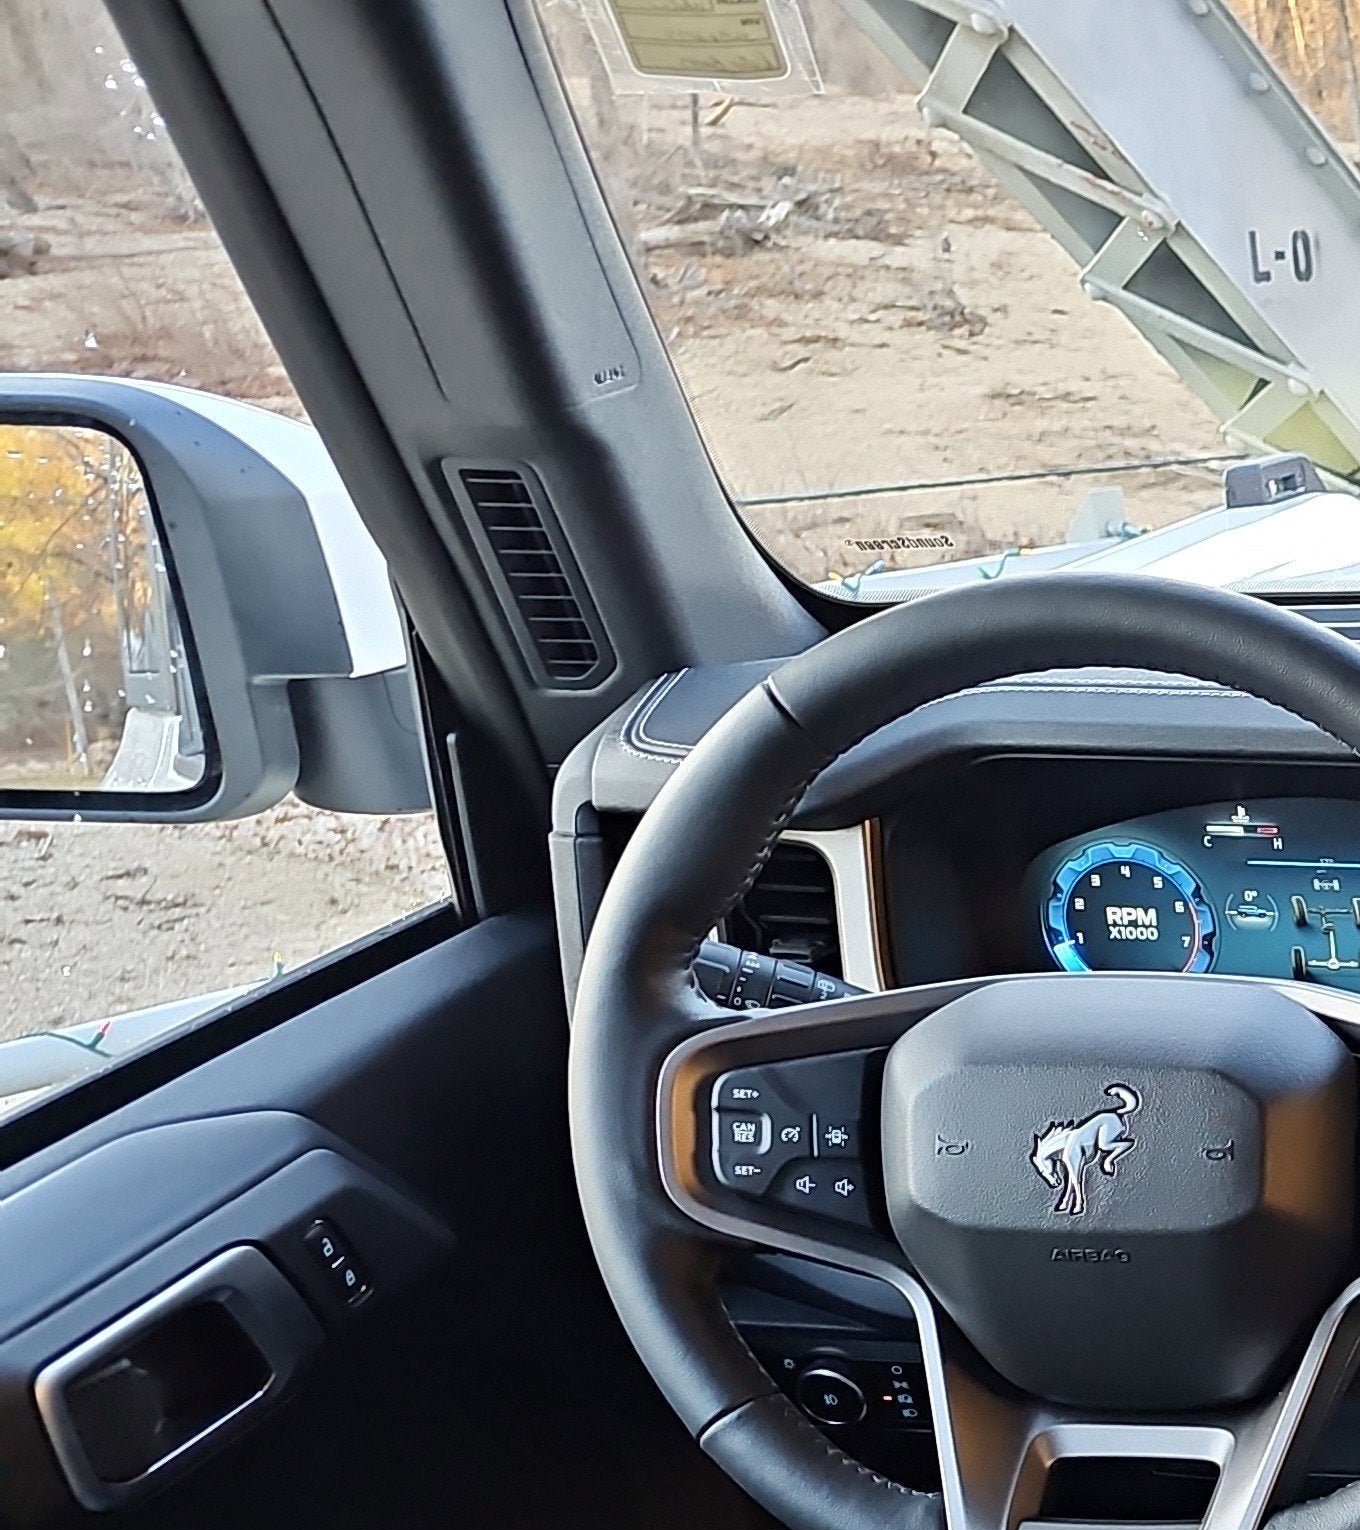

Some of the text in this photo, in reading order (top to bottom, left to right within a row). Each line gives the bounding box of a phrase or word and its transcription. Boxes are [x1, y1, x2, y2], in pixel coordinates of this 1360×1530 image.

[1203, 836, 1212, 848] C
[1273, 838, 1283, 850] H
[1120, 865, 1131, 878] 4
[1090, 874, 1101, 887] 3
[1153, 876, 1163, 889] 5
[1074, 897, 1085, 911] 2
[1174, 901, 1185, 913] 6
[1106, 906, 1158, 927] RPM
[1076, 932, 1084, 945] 1
[1109, 925, 1159, 941] X1000
[1181, 936, 1191, 948] 7
[732, 1121, 756, 1132] CAN
[1050, 1246, 1130, 1263] AIRBAG
